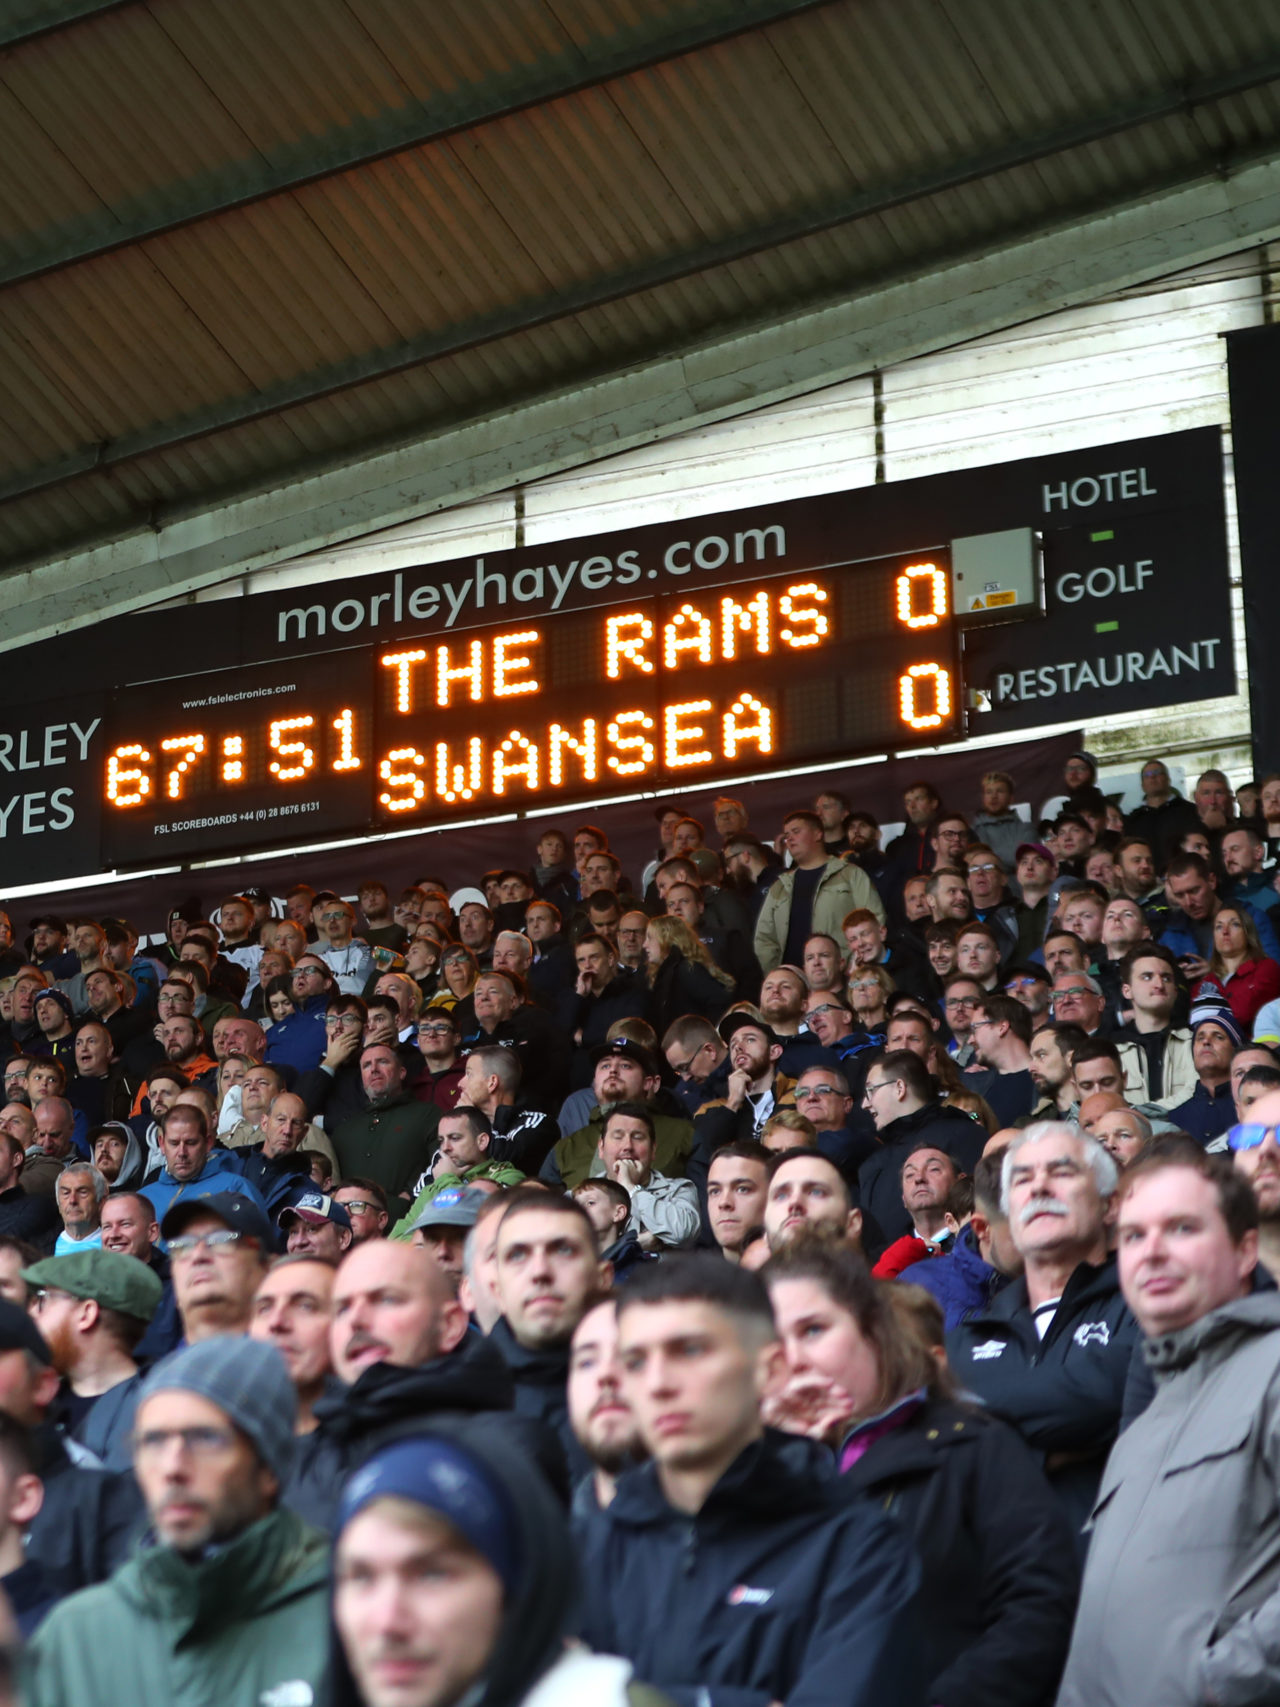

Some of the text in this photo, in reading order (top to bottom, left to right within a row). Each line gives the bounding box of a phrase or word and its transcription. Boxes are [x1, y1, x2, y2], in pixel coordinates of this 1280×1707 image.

[1043, 467, 1157, 513] HOTEL
[277, 524, 787, 642] morleyhayes.com
[1056, 560, 1154, 603] GOLF
[381, 563, 946, 712] THE RAMS 0
[182, 683, 296, 709] www.fslelectronics.com
[997, 638, 1221, 702] RESTAURANT
[106, 708, 362, 807] 67:51
[380, 663, 950, 811] SWANSEA 0
[154, 801, 320, 835] FSL SCOREBOARDS +44 (0) 28 8676 6131
